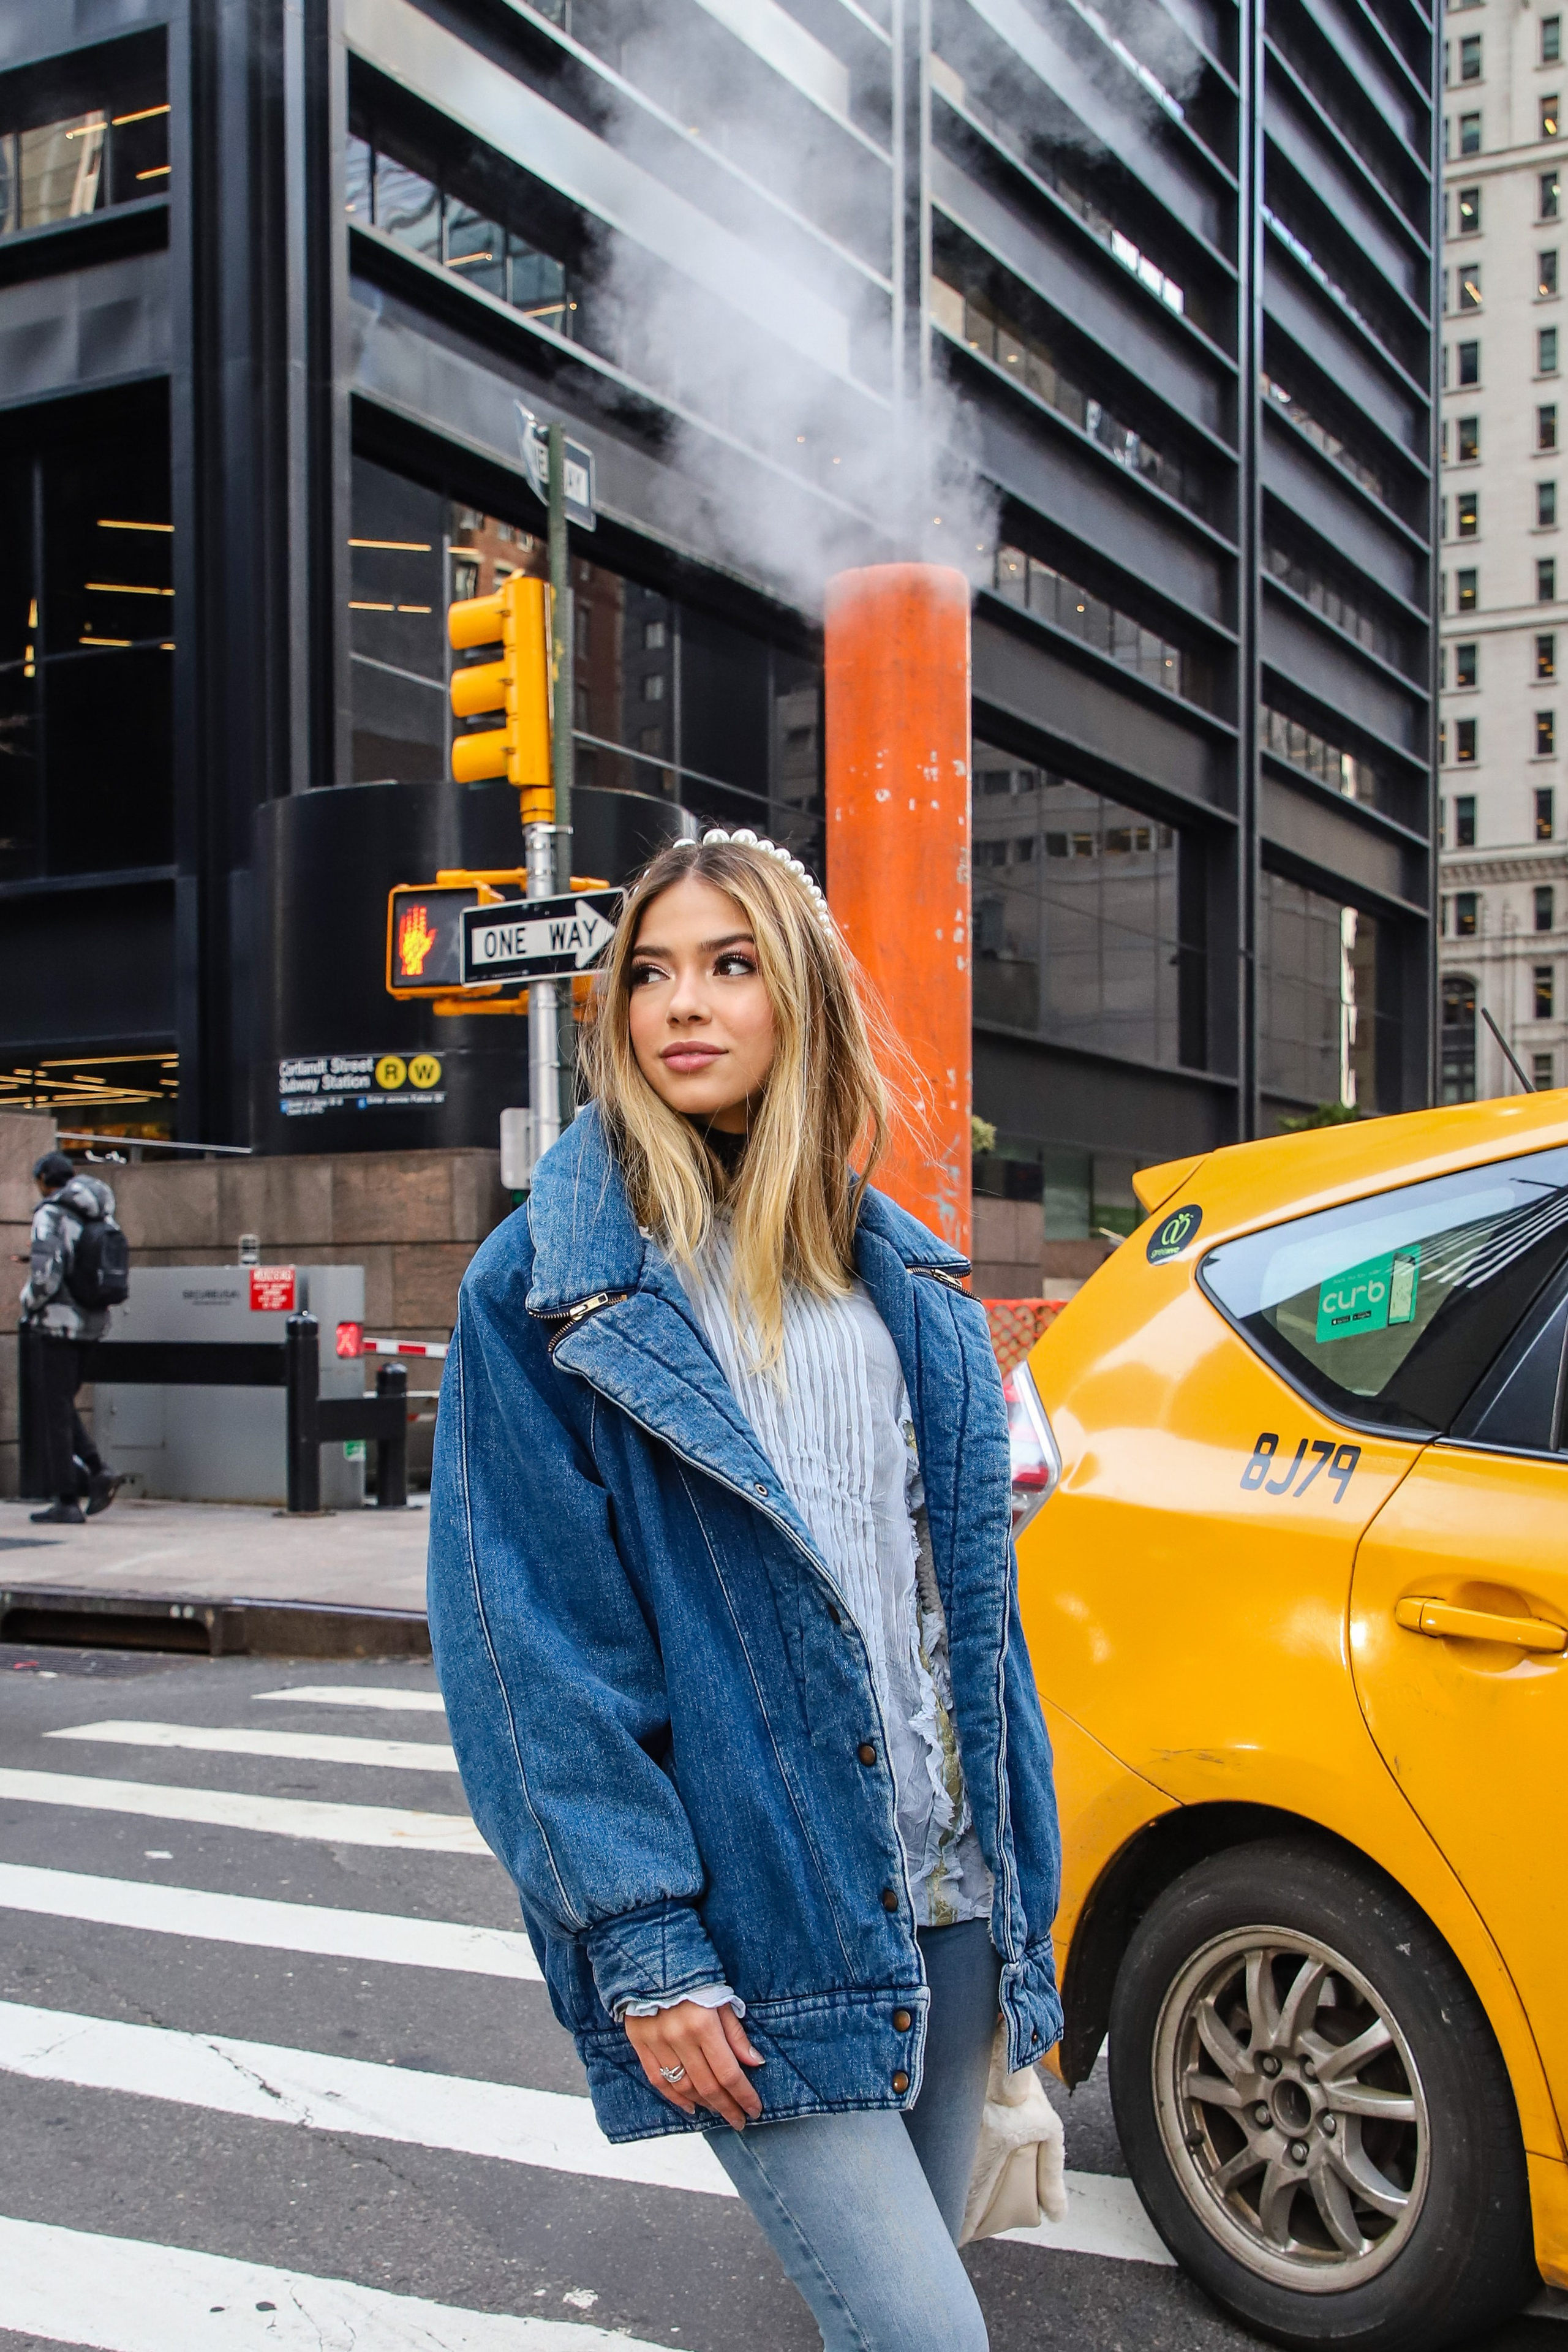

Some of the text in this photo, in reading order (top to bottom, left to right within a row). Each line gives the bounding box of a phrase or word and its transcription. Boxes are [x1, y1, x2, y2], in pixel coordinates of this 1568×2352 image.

[484, 919, 598, 957] ONE WAY
[279, 1057, 374, 1078] Cortlandt Street
[385, 1063, 435, 1080] R W
[279, 1074, 371, 1094] Subway Station
[1322, 1280, 1385, 1314] curb
[1240, 1433, 1361, 1504] 8J79
